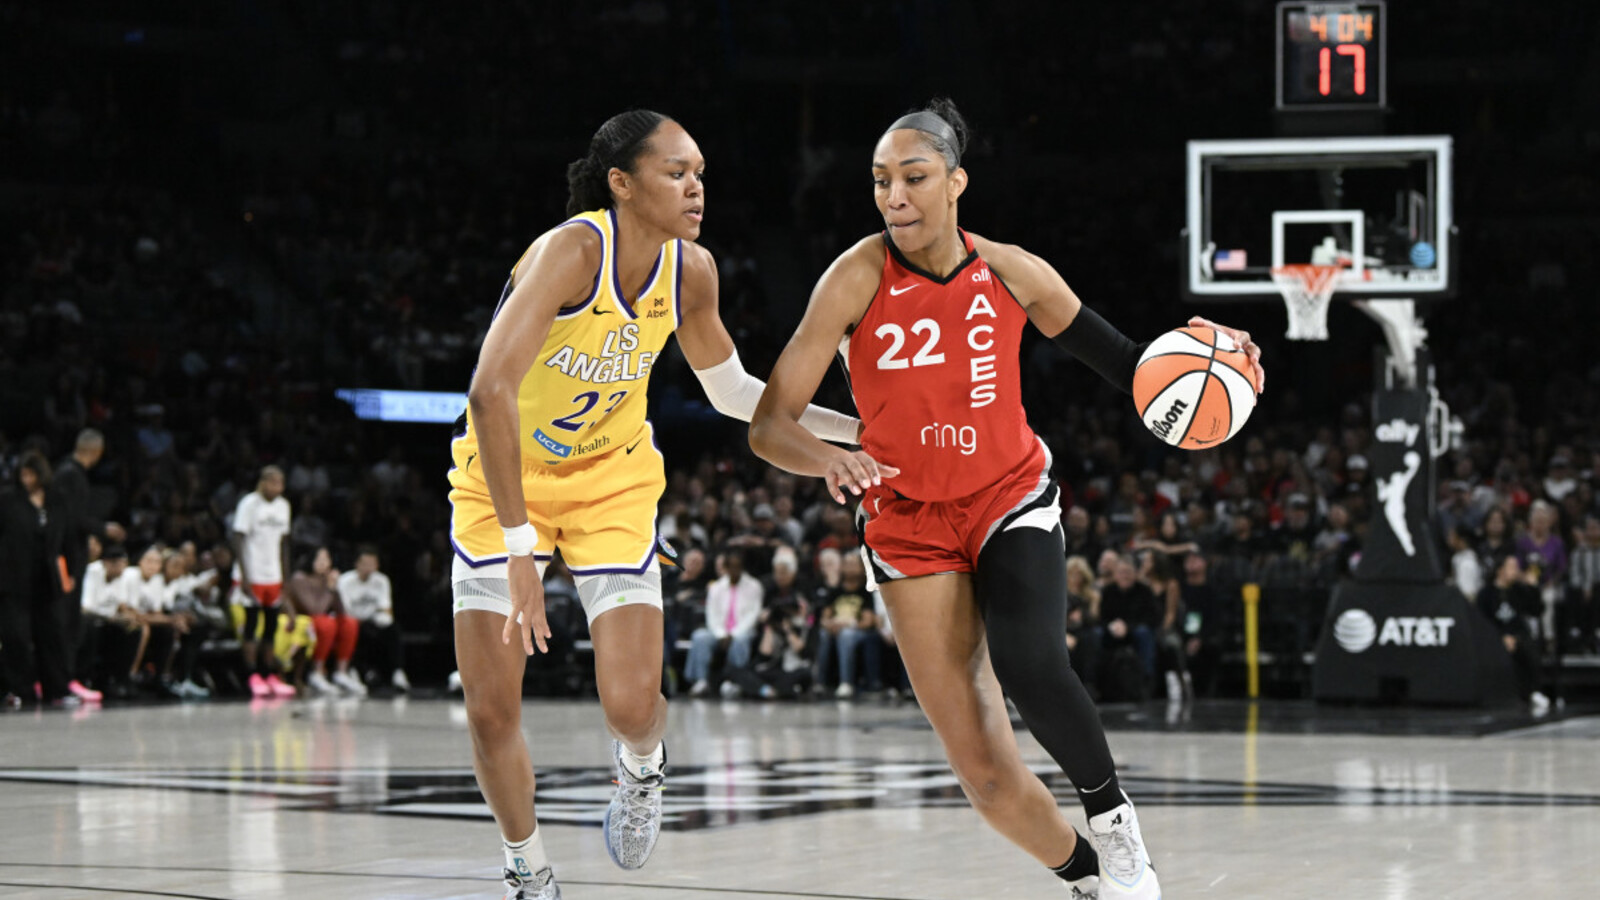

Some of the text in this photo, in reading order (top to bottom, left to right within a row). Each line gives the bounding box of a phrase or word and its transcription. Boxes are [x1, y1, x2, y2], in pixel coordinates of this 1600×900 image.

[1319, 44, 1366, 96] 17
[600, 322, 640, 358] LS
[874, 318, 946, 370] 22
[965, 294, 998, 408] ACES
[1150, 398, 1189, 440] lson
[1375, 418, 1420, 447] ally
[536, 433, 566, 456] UCLA
[920, 422, 977, 455] ring
[1378, 616, 1456, 647] AT&T
